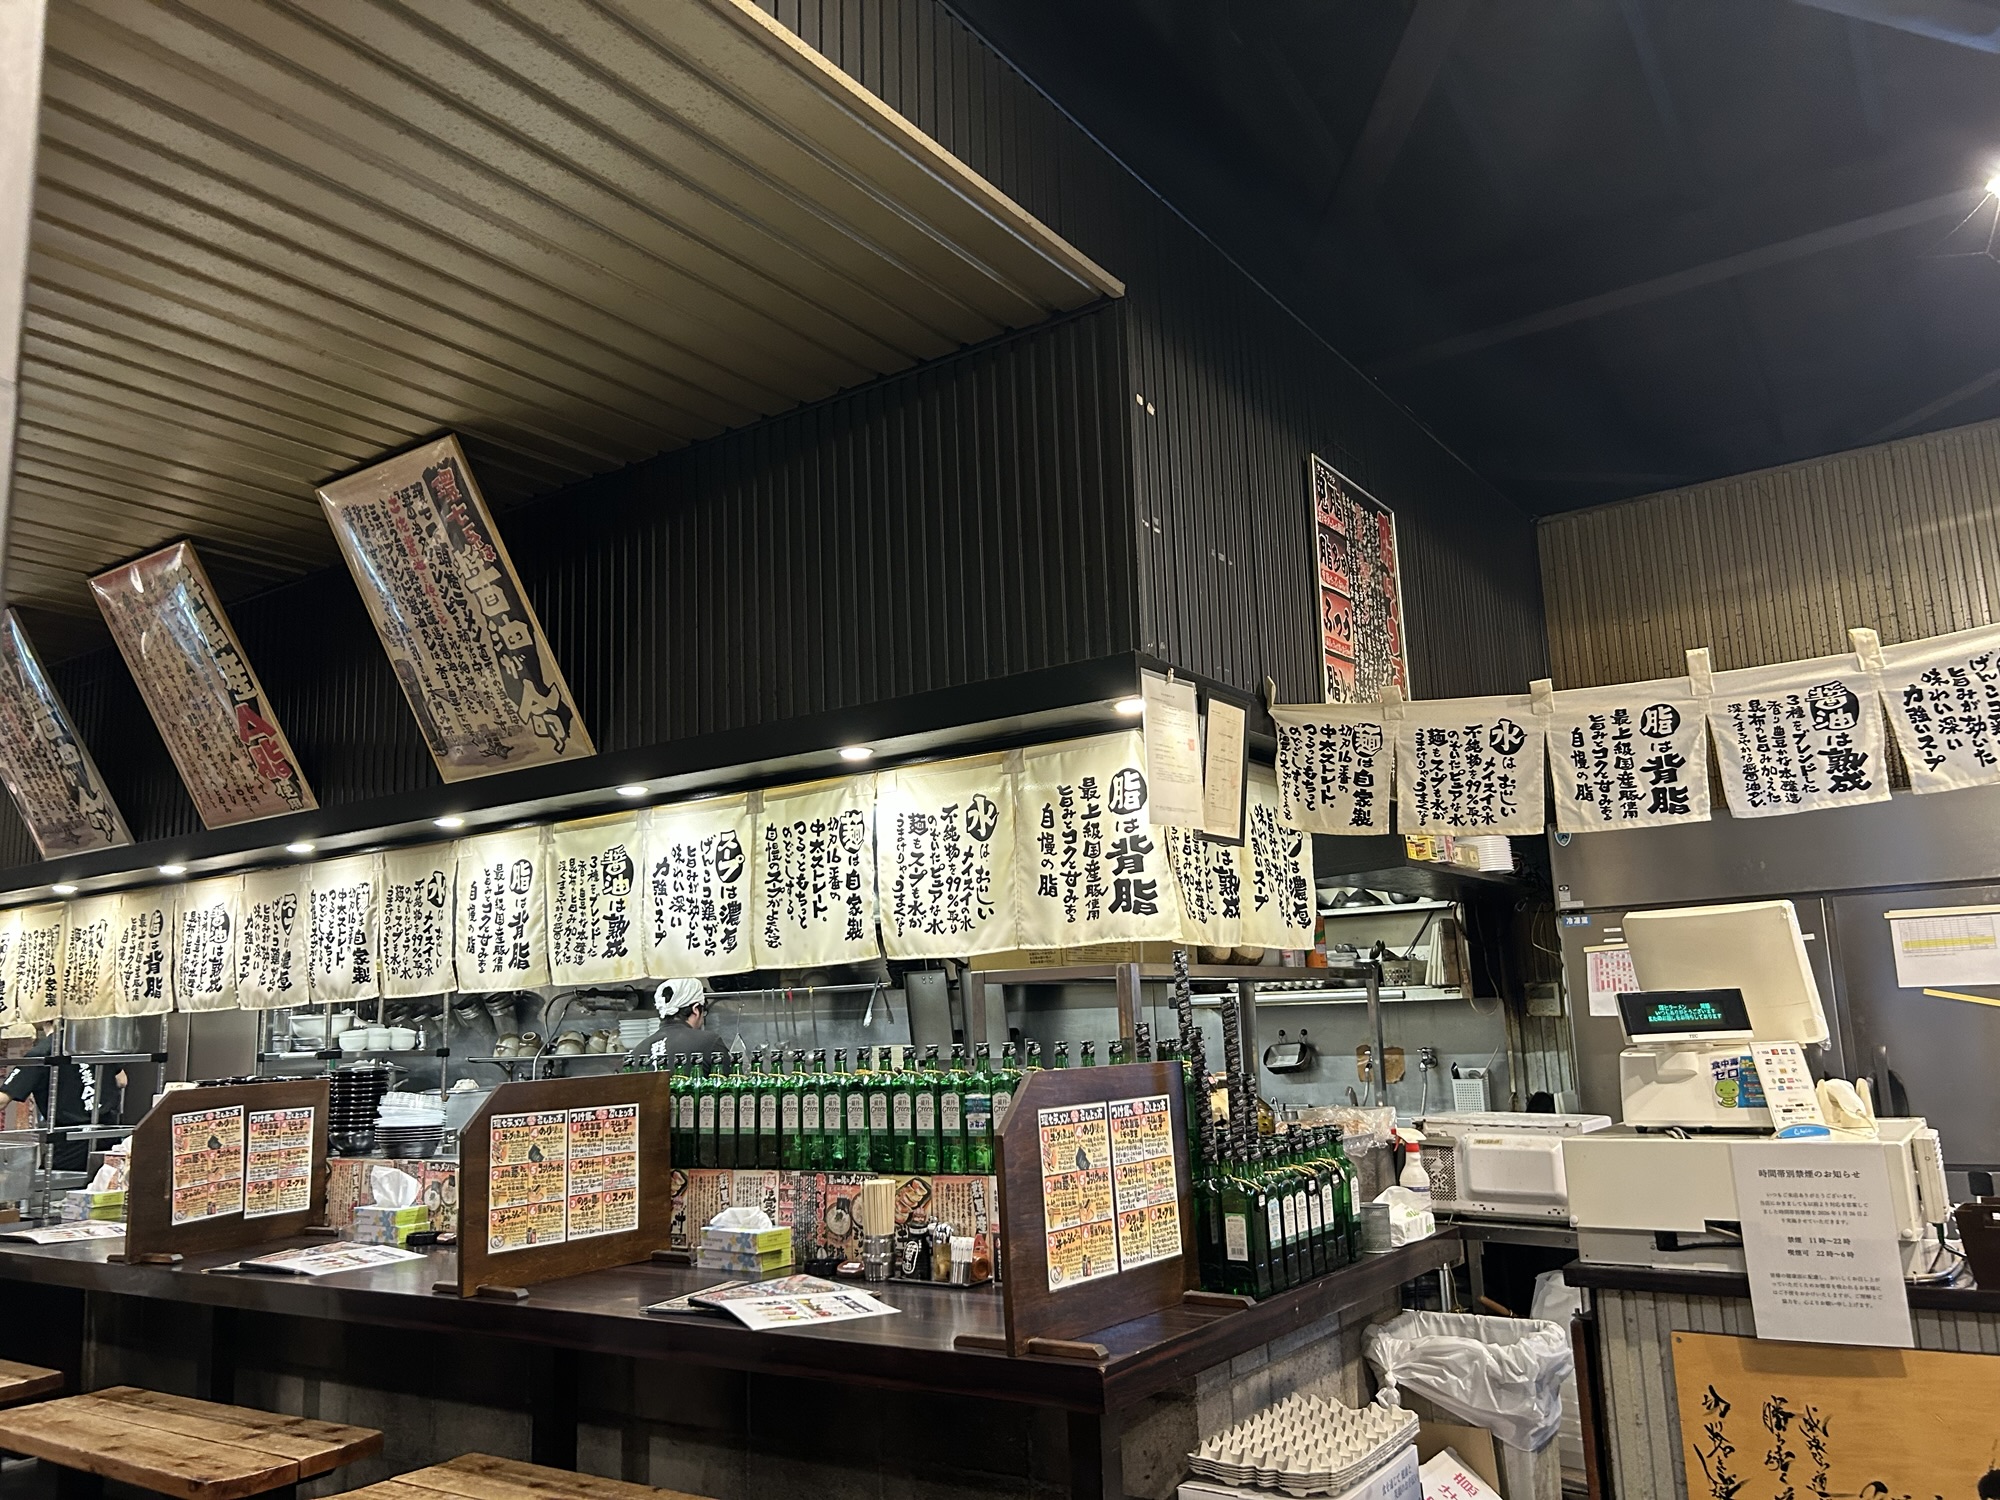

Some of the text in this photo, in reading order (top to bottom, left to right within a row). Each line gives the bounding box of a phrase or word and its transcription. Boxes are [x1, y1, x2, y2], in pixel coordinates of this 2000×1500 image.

[1323, 596, 1351, 642] ふつう
[1639, 703, 1691, 815] 脂は背脂
[1766, 700, 1802, 803] 香り豊かな本醸造
[1785, 695, 1820, 794] 3種をブレンドした
[1805, 680, 1872, 794] 醤油は熟成
[1903, 684, 1946, 772] 力強いスープ
[1921, 668, 1963, 750] 味わい深い
[1349, 723, 1383, 826] 麺は自家製
[1427, 728, 1448, 820] 麺もスープも水が
[1480, 757, 1497, 825] メイスイの水
[1571, 727, 1594, 801] 自慢の脂
[1588, 715, 1614, 821] 旨みとコクと甘みある
[1610, 709, 1646, 818] 最上級国産豚使用
[669, 843, 686, 928] 味わい深い
[715, 829, 745, 954] スープは濃厚
[794, 821, 809, 929] つるっともちっと
[839, 810, 864, 941] 麺は自家製
[907, 813, 929, 928] 麺もスープも水が
[960, 845, 976, 932] メイスイの水
[1037, 803, 1058, 897] 自慢の脂
[1057, 785, 1082, 923] 旨みとコクと甘みある
[1078, 777, 1108, 921] 最上級国産豚使用
[1105, 768, 1159, 915] 脂は背脂
[508, 859, 533, 970] 脂は背脂
[652, 856, 670, 948] 力強いスープ
[1711, 1058, 1739, 1070] 食中毒
[1758, 1170, 1861, 1178] 時間帯別禁煙のお知らせ
